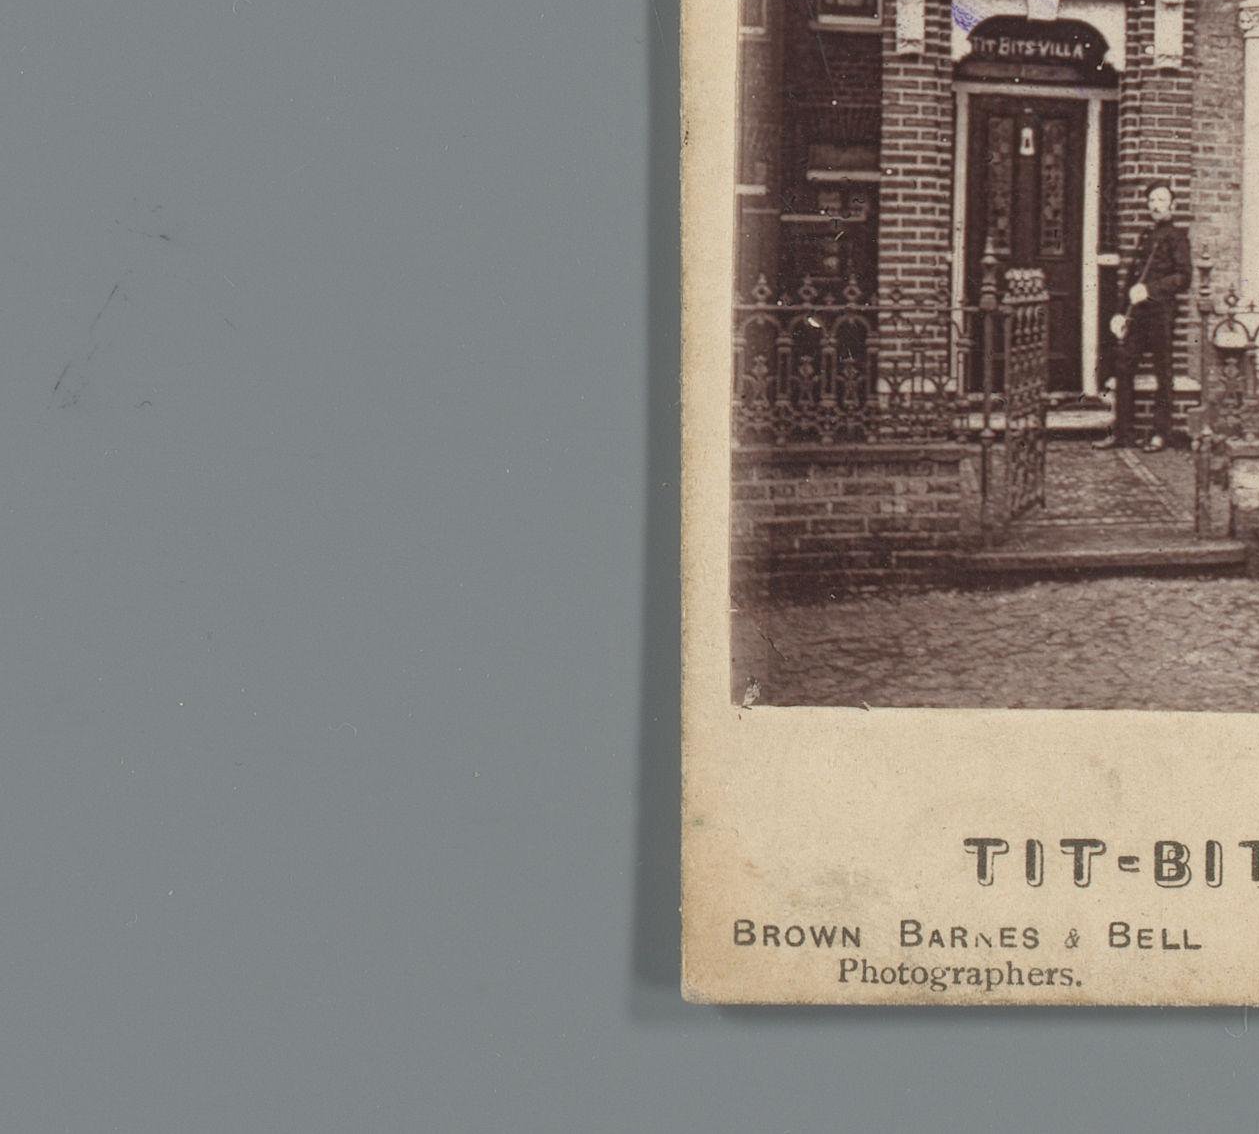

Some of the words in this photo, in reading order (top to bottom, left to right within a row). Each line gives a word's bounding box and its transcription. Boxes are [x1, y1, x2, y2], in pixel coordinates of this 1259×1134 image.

[733, 919, 861, 949] BROWN
[1064, 928, 1080, 949] &
[1108, 921, 1202, 951] BELL
[837, 957, 1082, 995] Photographers.
